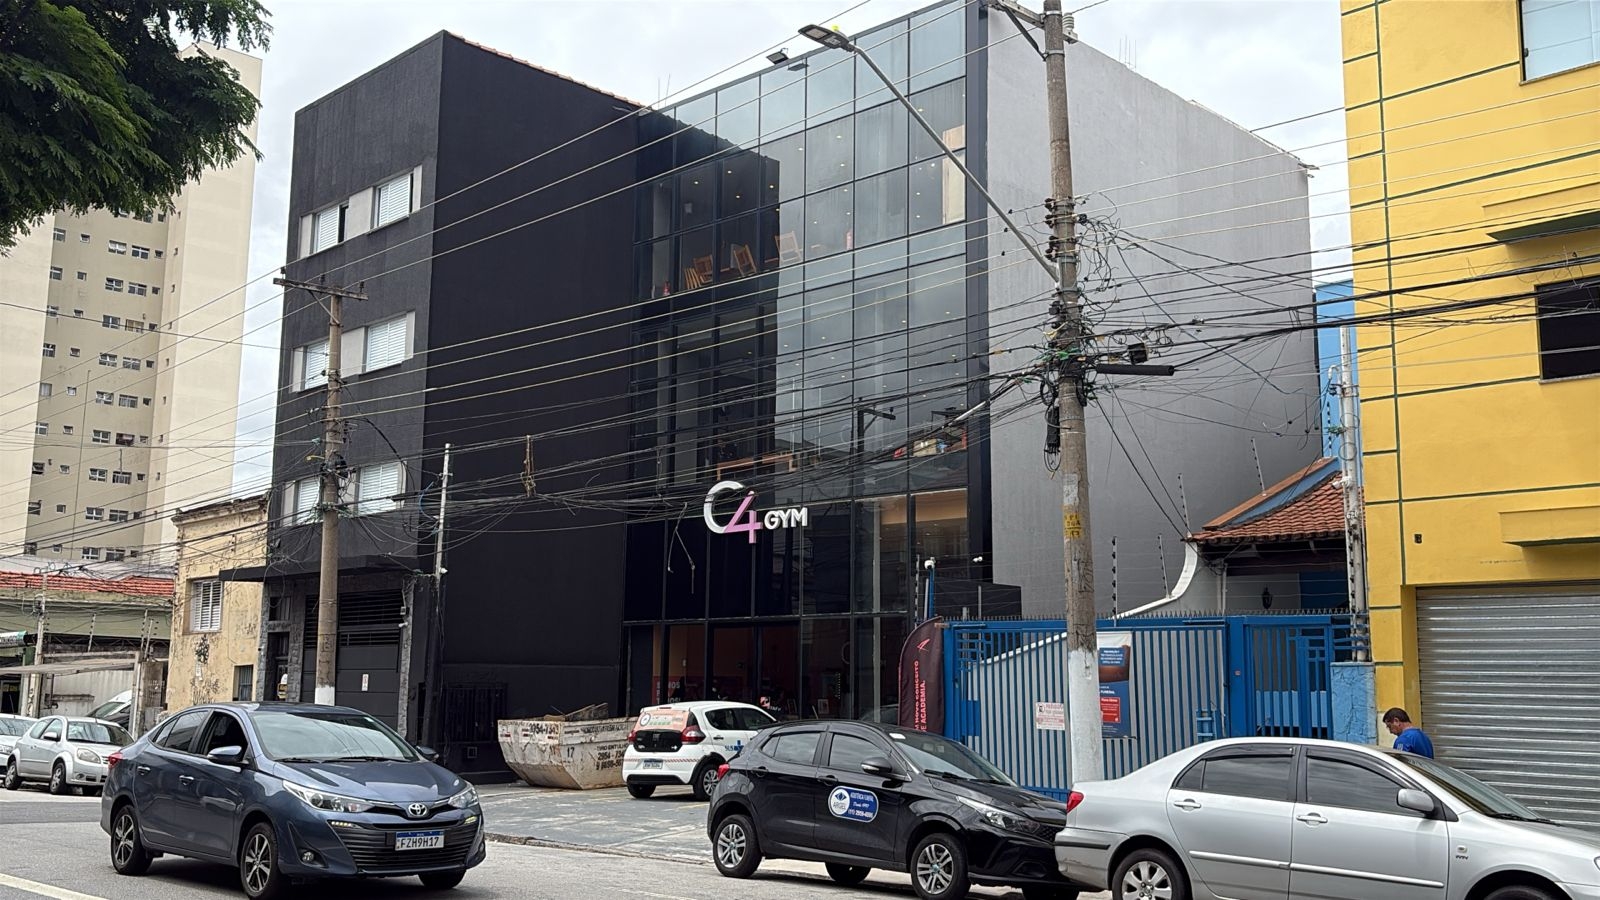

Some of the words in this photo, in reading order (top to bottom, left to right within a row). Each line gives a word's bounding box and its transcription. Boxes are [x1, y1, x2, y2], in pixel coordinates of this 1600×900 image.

[703, 480, 763, 544] C4
[764, 507, 808, 530] GYM
[919, 680, 927, 723] ACADEMIA.
[566, 747, 575, 758] 17
[400, 836, 440, 849] FZH9H17
